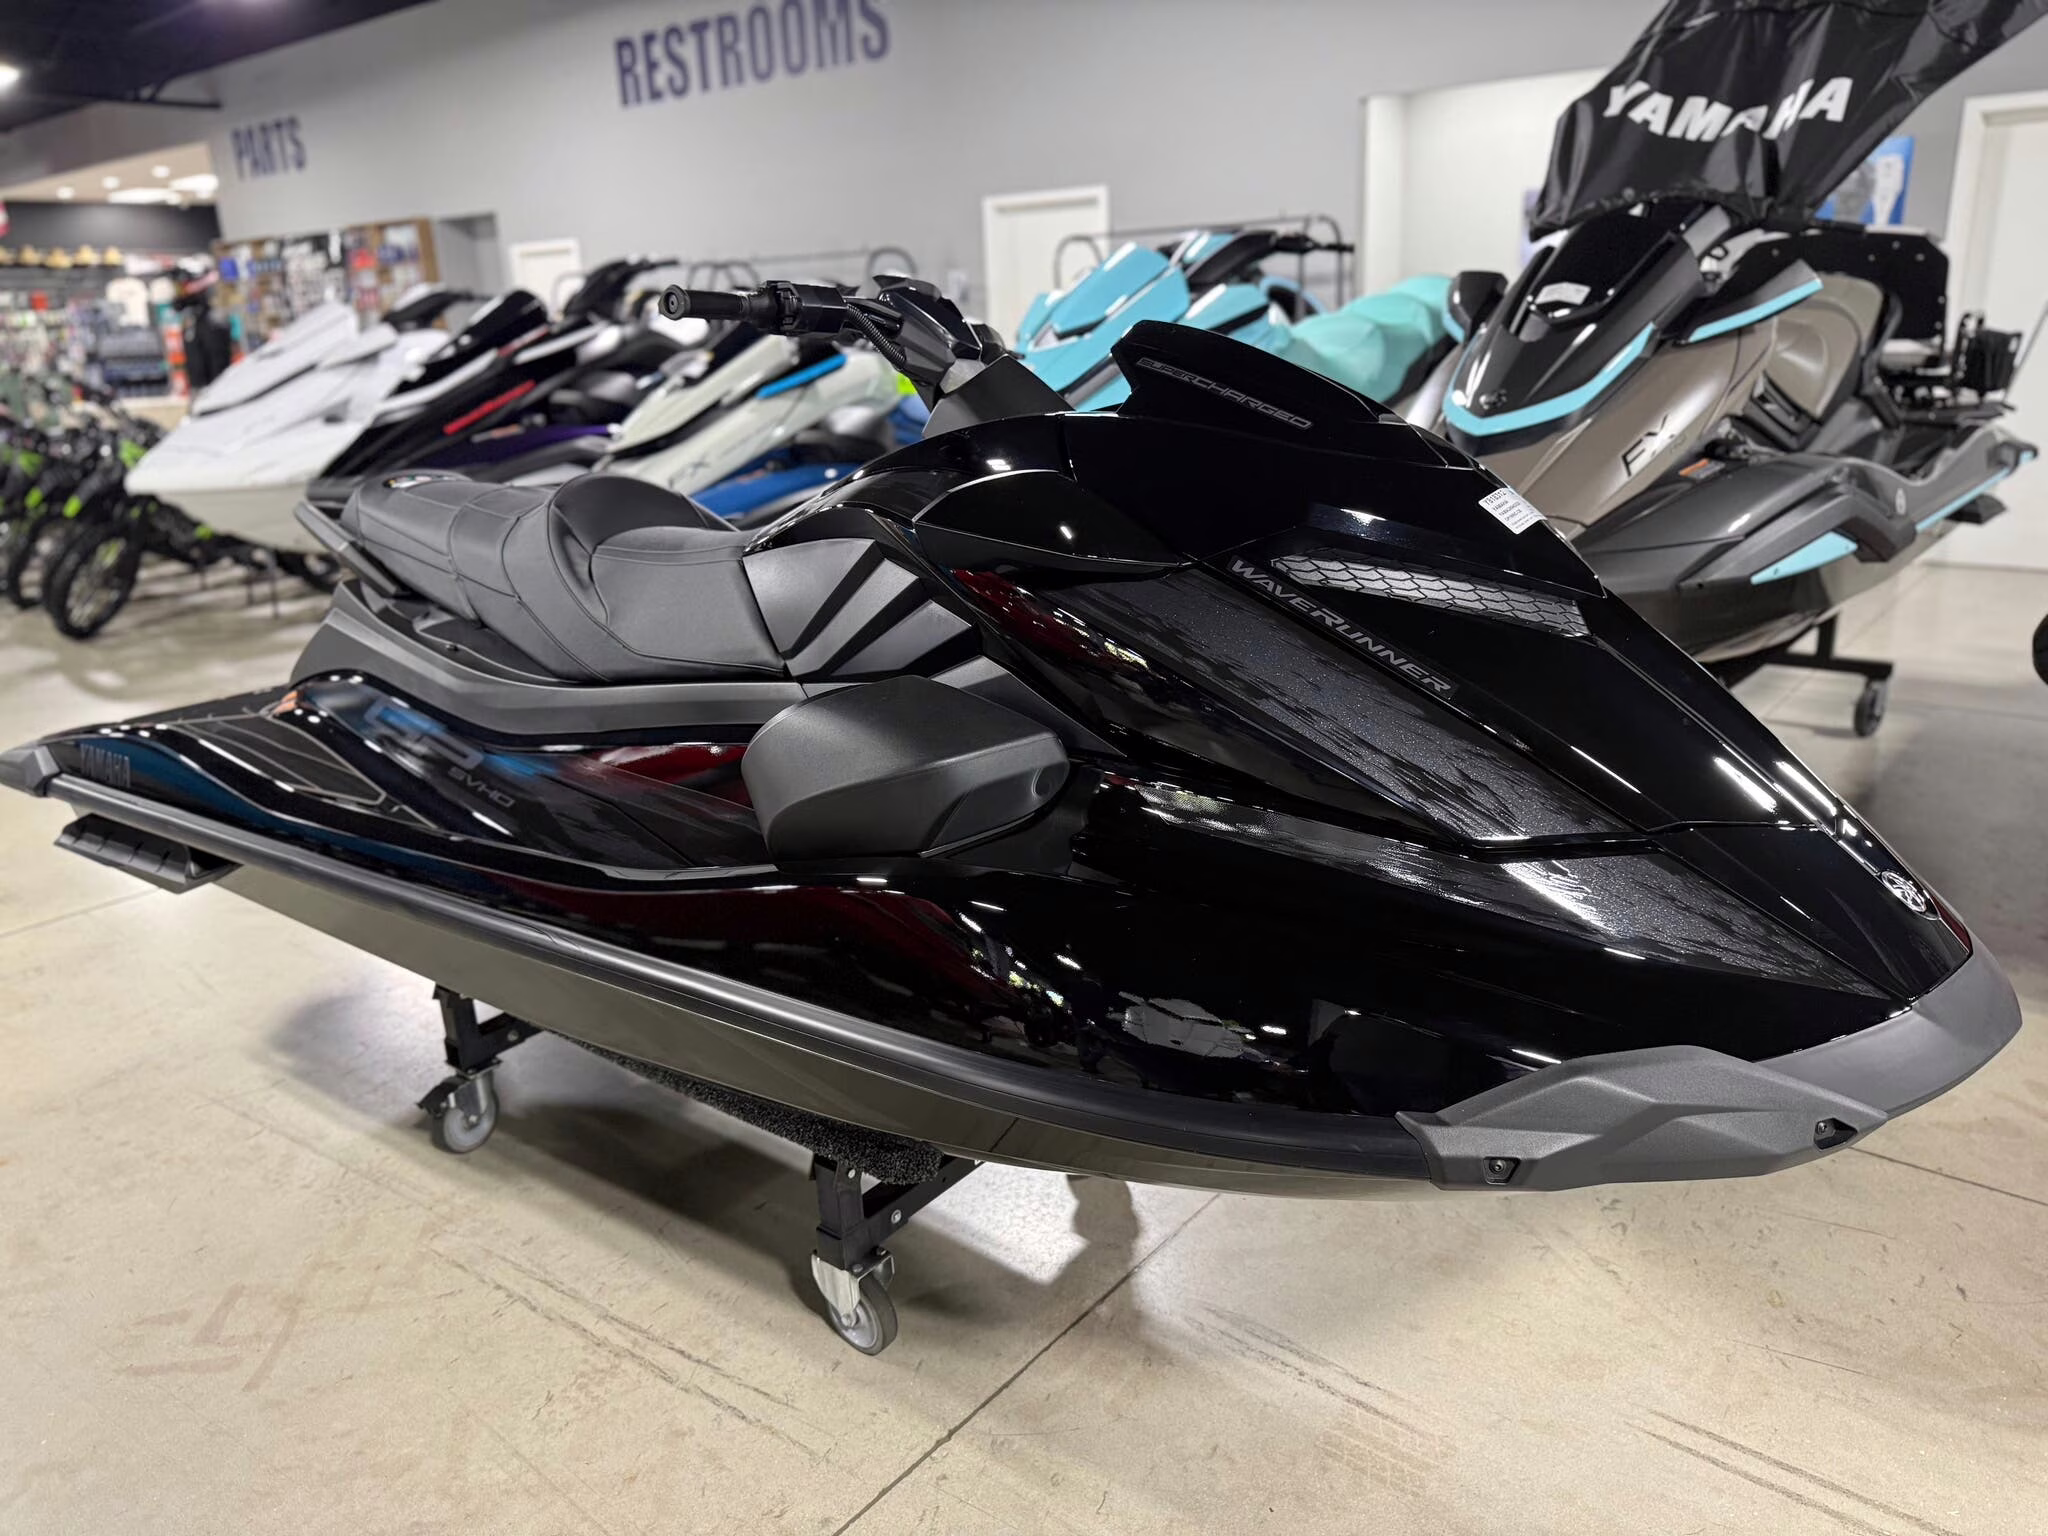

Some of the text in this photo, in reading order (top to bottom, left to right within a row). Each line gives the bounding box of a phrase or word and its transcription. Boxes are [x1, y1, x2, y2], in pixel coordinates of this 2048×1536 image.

[614, 0, 891, 106] RESTROOMS
[1603, 76, 1853, 142] YAMAHA
[232, 115, 306, 180] PARTS
[1136, 357, 1313, 430] SUPERCHARGED
[1622, 414, 1676, 477] FX
[1231, 560, 1451, 692] WAVERUNNER
[80, 743, 130, 787] YAMAHA
[448, 766, 514, 807] SVHO
